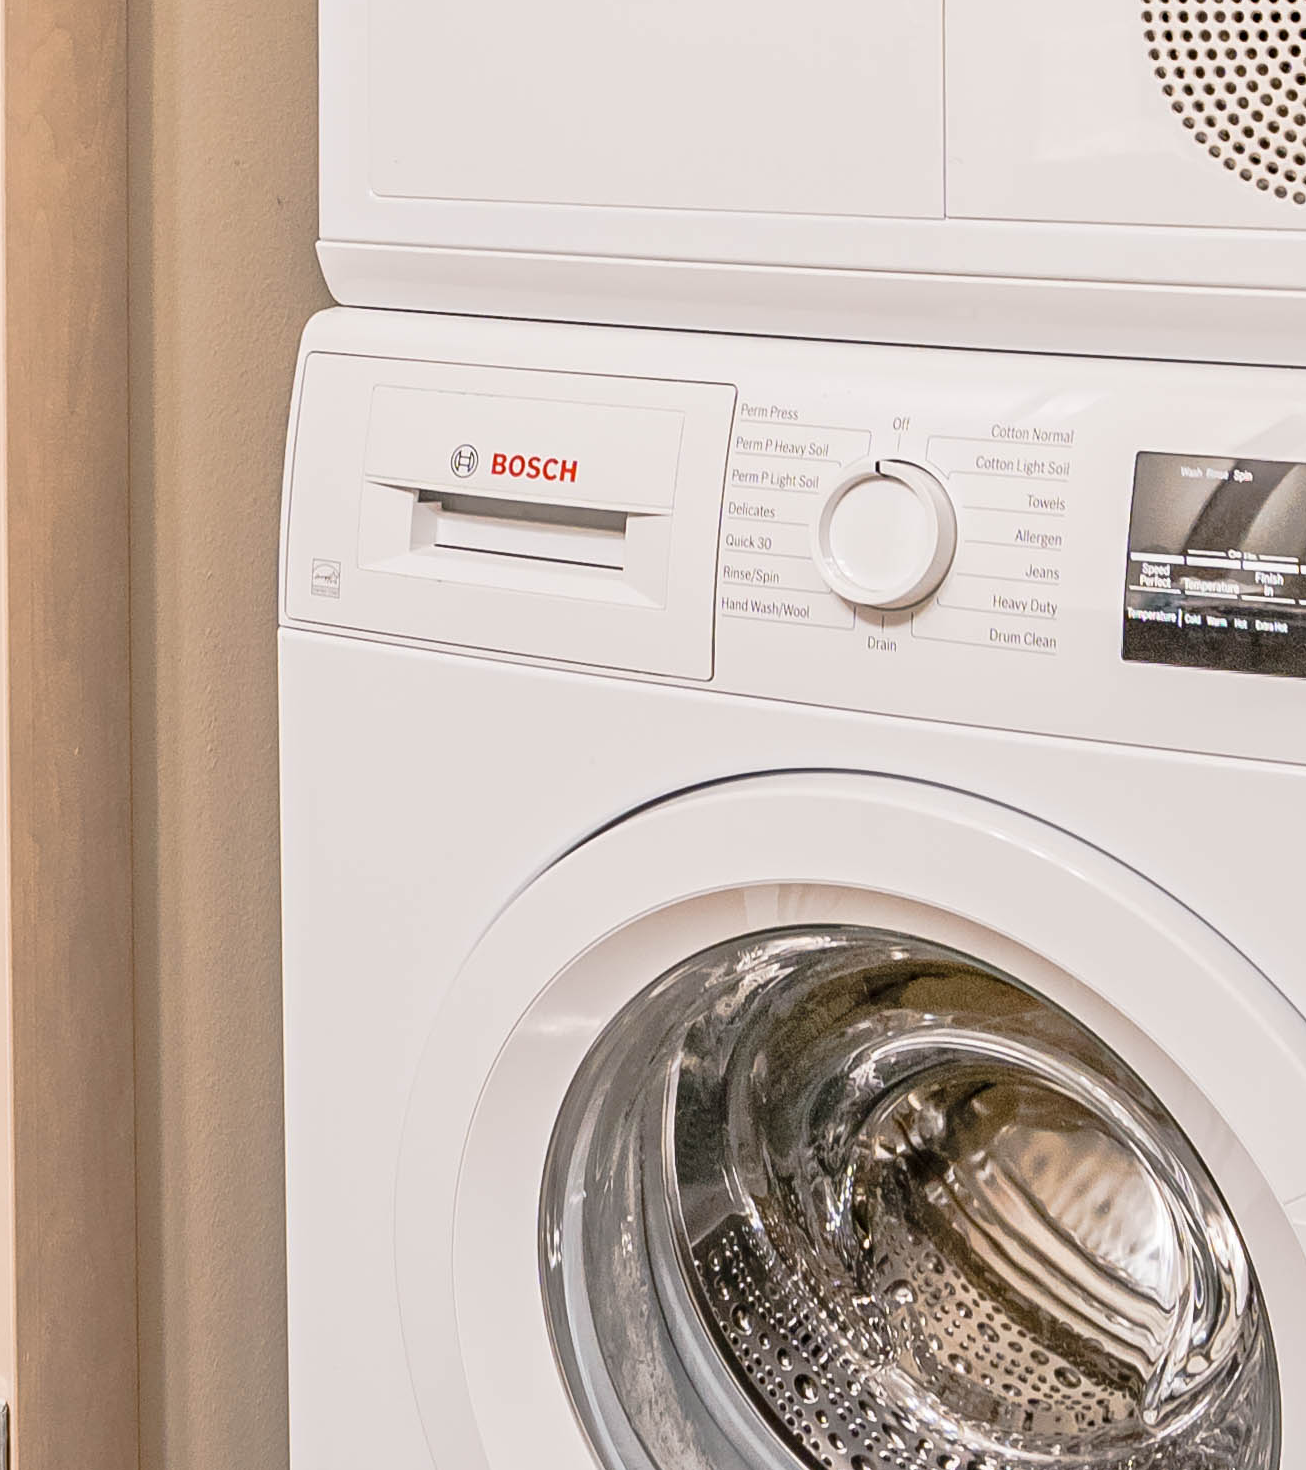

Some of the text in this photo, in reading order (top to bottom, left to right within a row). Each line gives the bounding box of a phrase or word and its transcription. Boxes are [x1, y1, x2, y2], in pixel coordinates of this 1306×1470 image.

[741, 403, 799, 420] Perm Press
[893, 417, 910, 431] Off
[991, 424, 1074, 444] Cotton Normal
[736, 436, 829, 457] Perm P Heavy Soil
[491, 453, 578, 483] BOSCH
[975, 455, 1070, 476] Cotton Light Soil
[732, 468, 820, 489] Perm P Light Soil
[1233, 469, 1253, 483] Spin
[728, 501, 775, 518] Delicates
[1027, 494, 1066, 510] Towels
[726, 533, 772, 550] Quick 30
[1015, 528, 1062, 548] Allergen
[723, 565, 780, 584] Rinse/Spin
[1025, 563, 1060, 580] Jeans
[1142, 562, 1170, 576] Speed
[1140, 574, 1172, 588] Perfect
[1184, 579, 1240, 594] Temperature
[1255, 571, 1284, 586] Finish
[721, 597, 810, 619] Hand Wash/Wool
[993, 594, 1058, 617] Heavy Duty
[1127, 607, 1177, 623] Temperature
[1234, 617, 1248, 630] Hot
[867, 636, 897, 653] Drain
[989, 627, 1057, 649] Drum Clean
